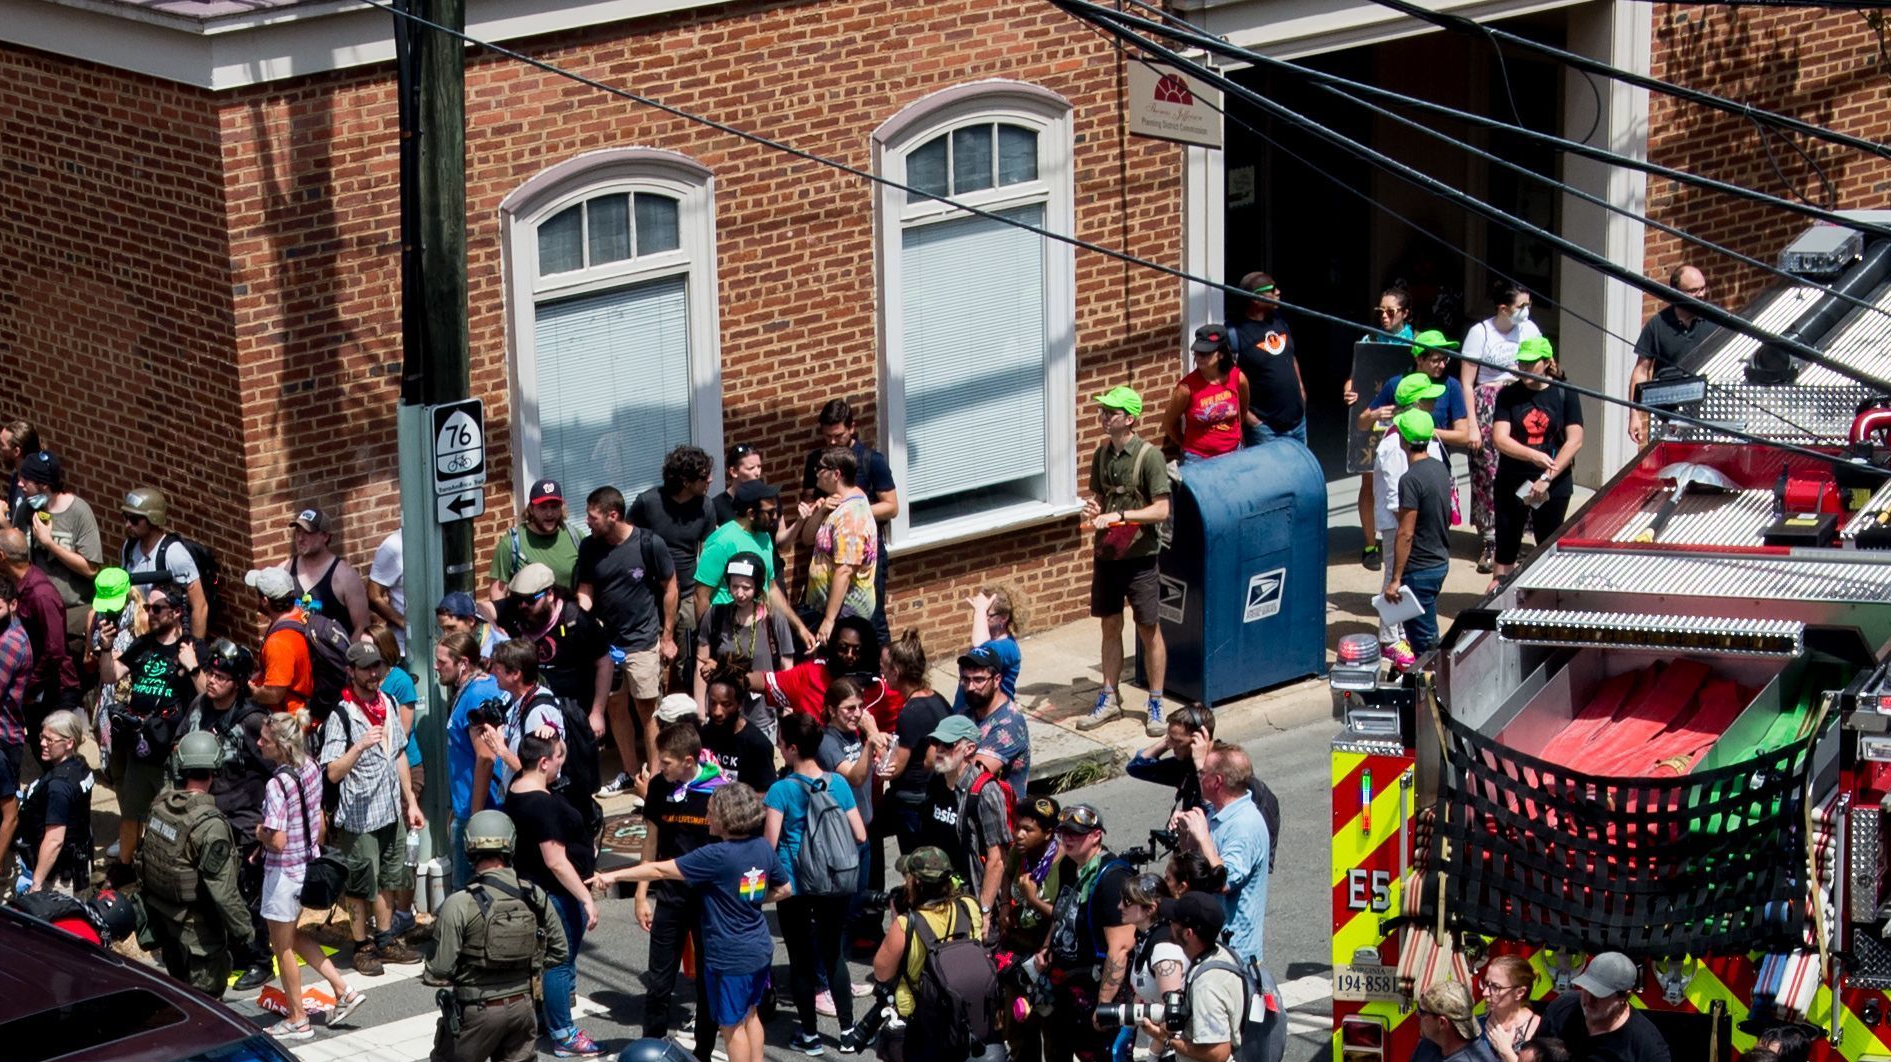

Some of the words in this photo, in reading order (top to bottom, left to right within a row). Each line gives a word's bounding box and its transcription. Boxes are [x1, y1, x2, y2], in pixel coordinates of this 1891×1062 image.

[445, 423, 472, 449] 76
[716, 753, 739, 768] ACK
[932, 803, 957, 825] esis
[1347, 868, 1391, 913] E5
